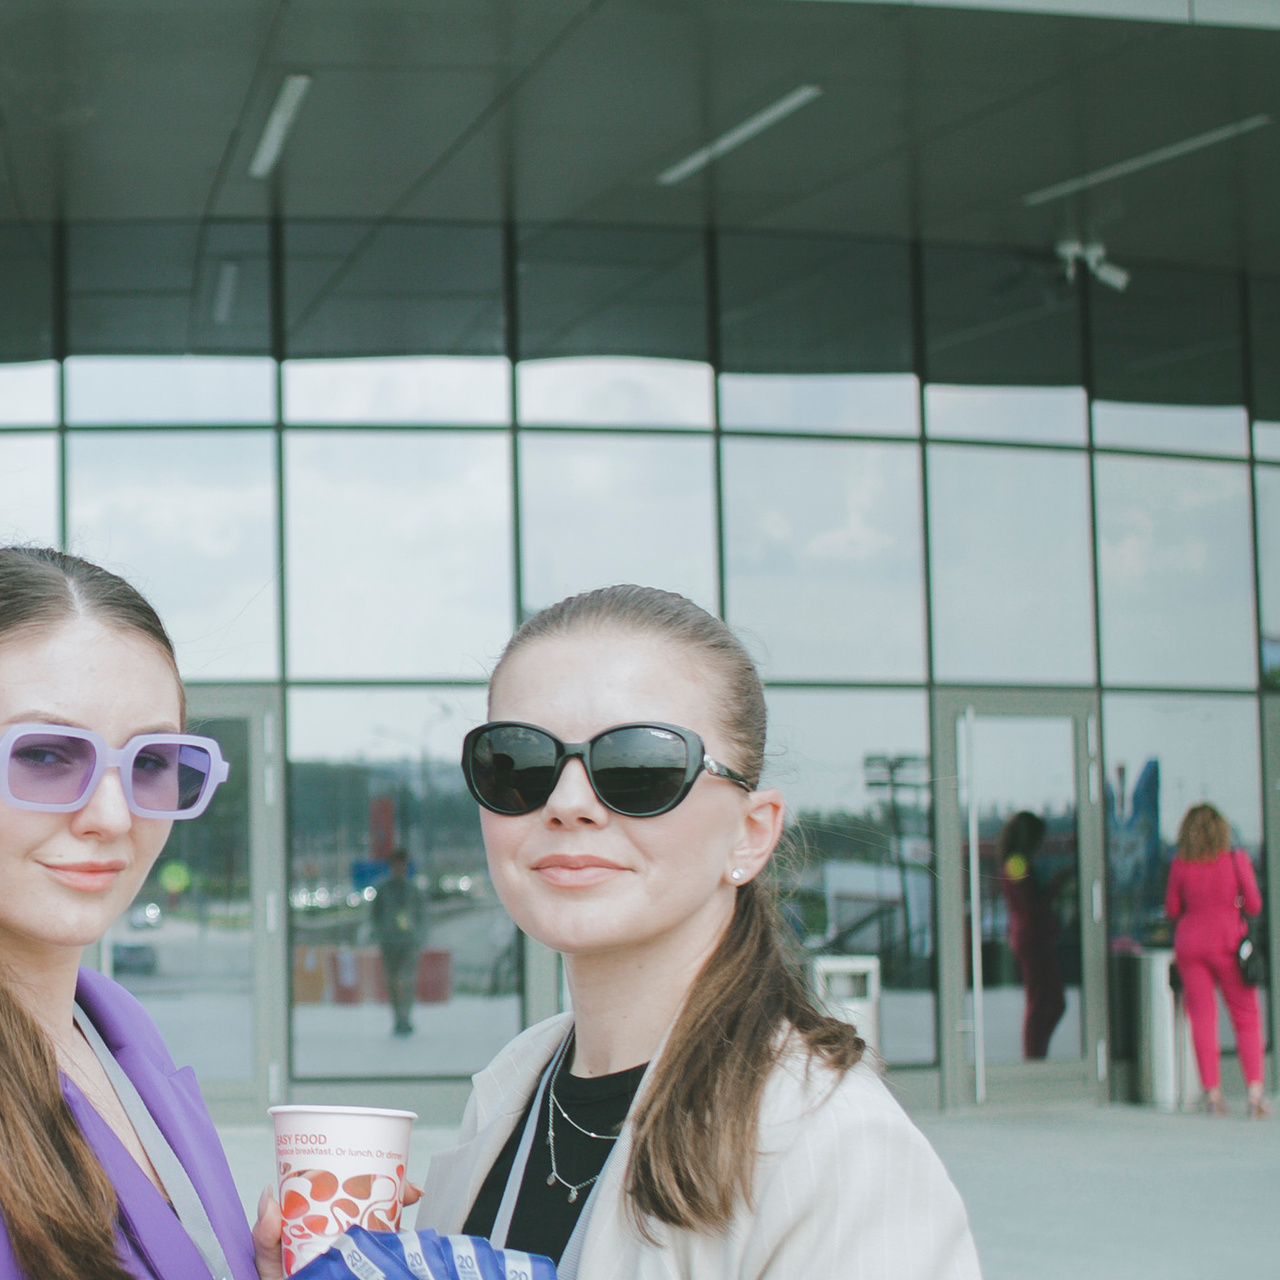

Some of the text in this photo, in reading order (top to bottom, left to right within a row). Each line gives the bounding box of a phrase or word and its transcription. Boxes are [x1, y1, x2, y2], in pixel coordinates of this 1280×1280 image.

[294, 1133, 328, 1146] FOOD
[335, 1147, 347, 1157] Or
[375, 1149, 386, 1159] Or
[346, 1249, 363, 1268] 20
[407, 1251, 423, 1268] 20
[456, 1254, 474, 1269] 20
